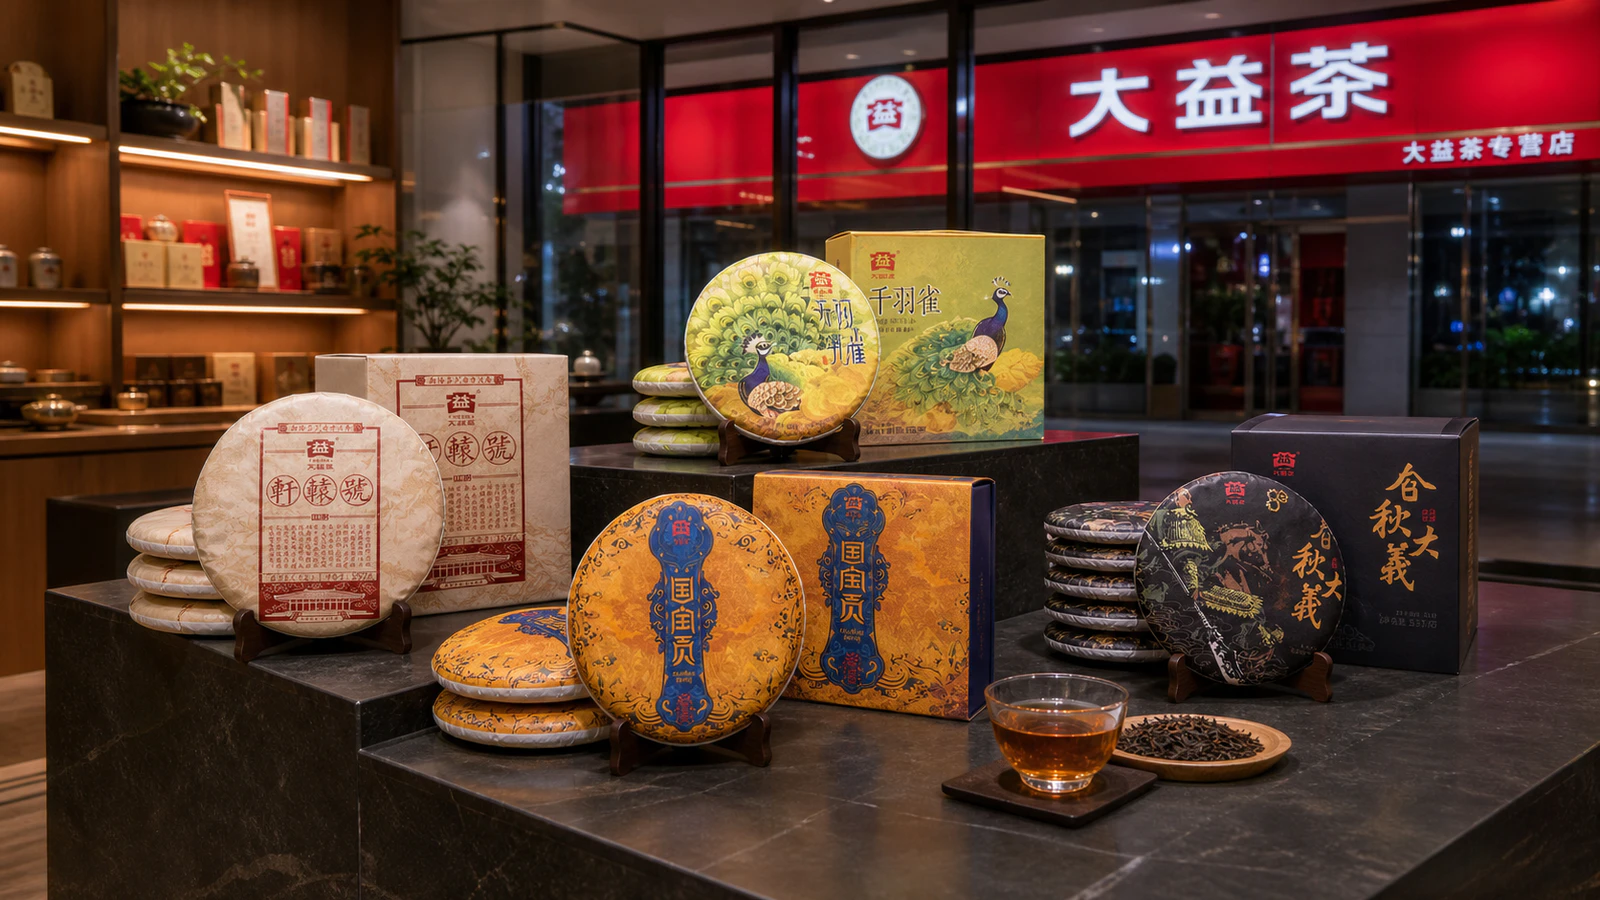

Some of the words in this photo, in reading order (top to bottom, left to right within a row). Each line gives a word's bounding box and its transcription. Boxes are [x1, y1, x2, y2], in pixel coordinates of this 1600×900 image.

[1069, 42, 1389, 138] 大益茶
[1402, 130, 1575, 164] 大益茶专营店
[869, 284, 942, 316] 千羽雀
[424, 434, 515, 464] 轅號
[269, 477, 372, 505] 軒轅號
